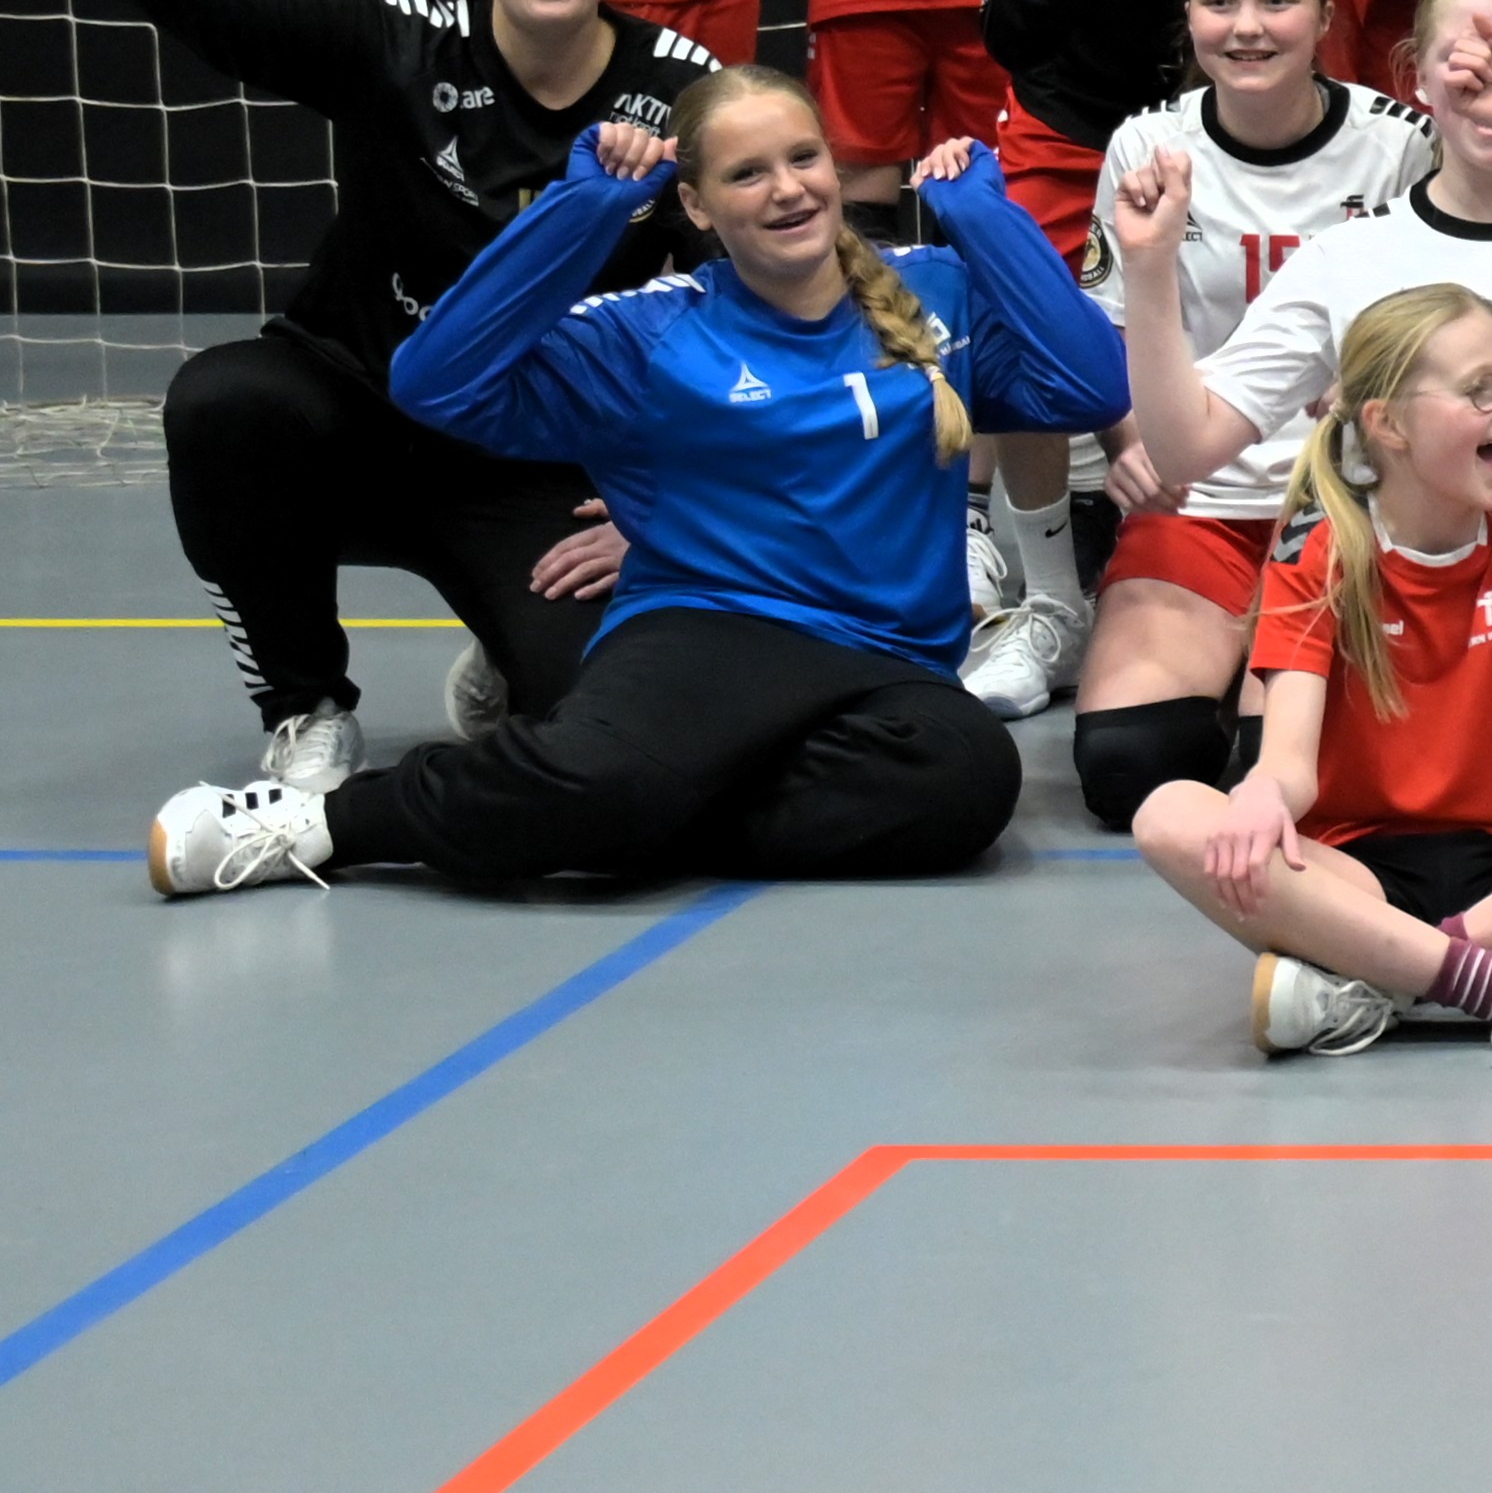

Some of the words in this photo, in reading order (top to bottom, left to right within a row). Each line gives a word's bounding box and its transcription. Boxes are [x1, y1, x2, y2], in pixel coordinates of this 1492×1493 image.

[613, 94, 672, 125] AKTI
[729, 389, 771, 403] SELECT
[843, 372, 879, 440] 1
